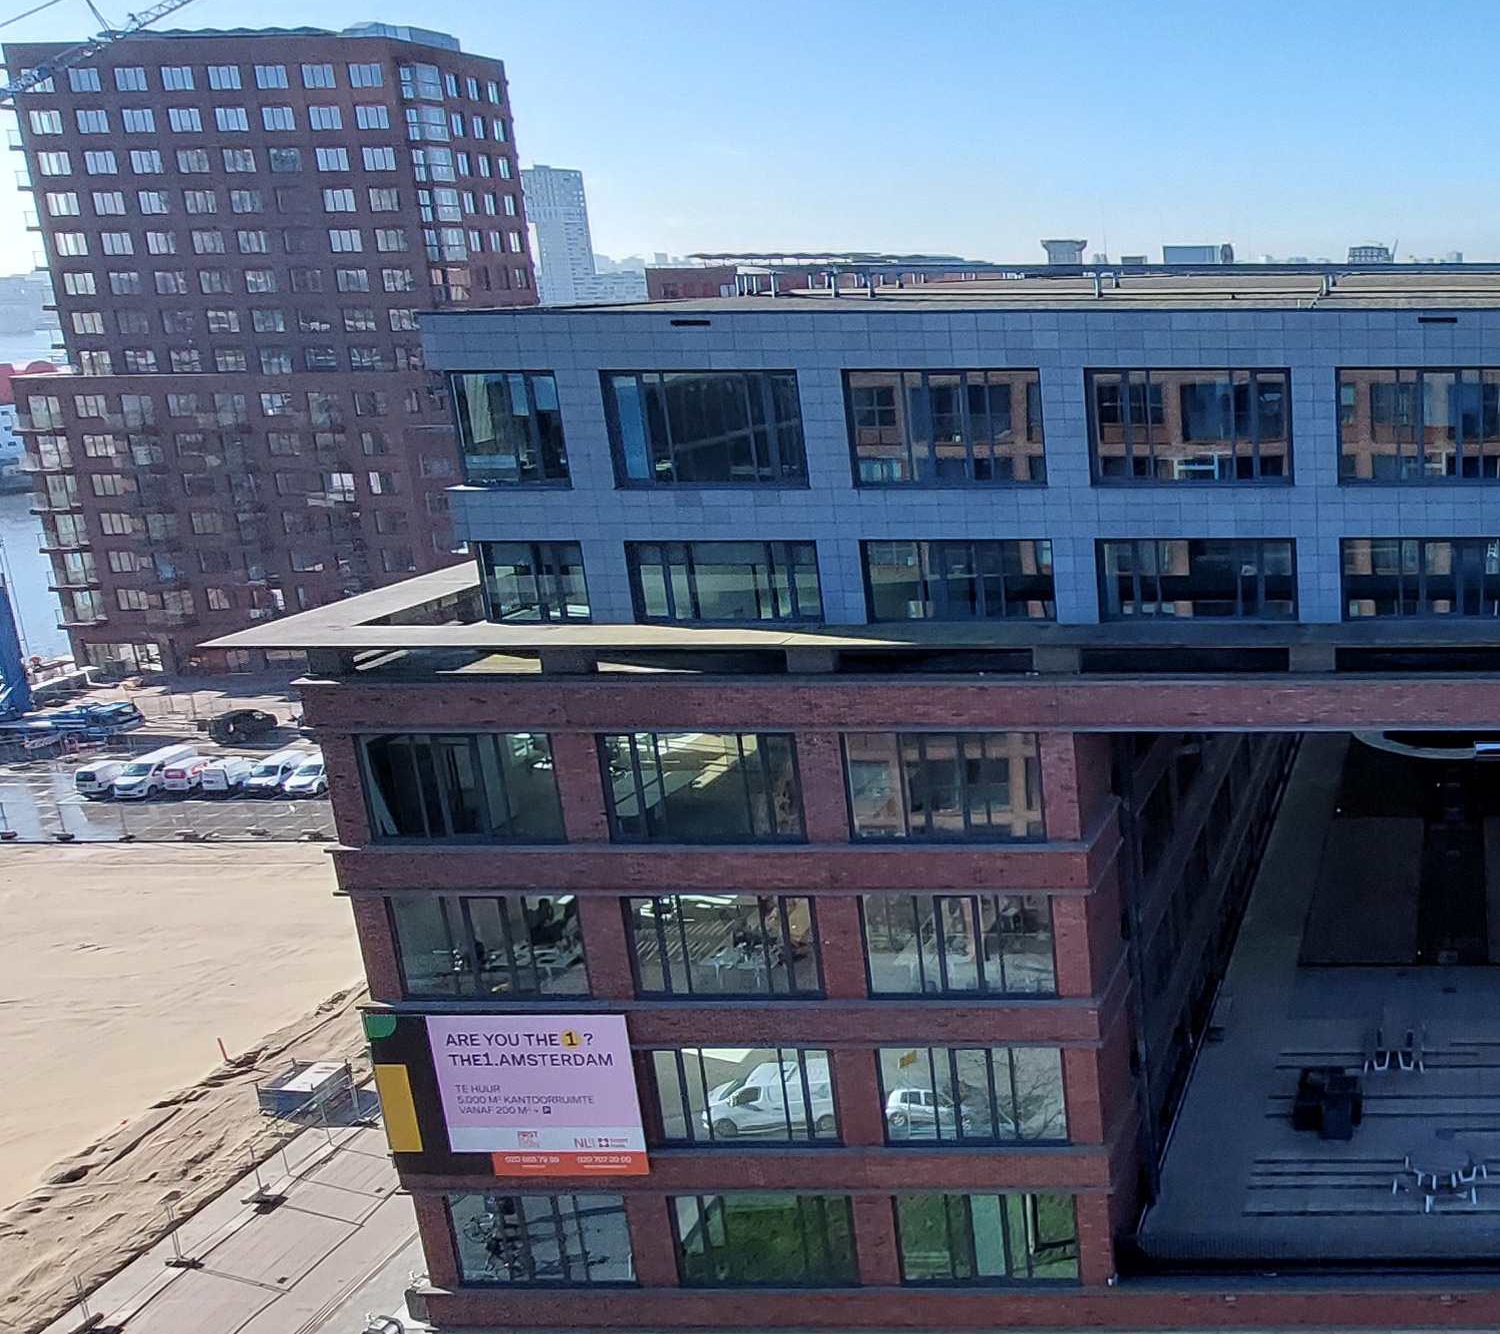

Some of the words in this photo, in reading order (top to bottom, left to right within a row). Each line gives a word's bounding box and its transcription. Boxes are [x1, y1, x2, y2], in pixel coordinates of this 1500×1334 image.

[446, 1033, 480, 1047] ARE
[483, 1033, 520, 1047] YOU
[524, 1033, 560, 1047] THE
[566, 1032, 578, 1047] 1
[583, 1033, 594, 1046] ?
[448, 1053, 614, 1067] THE1.AMSTERDAM
[454, 1084, 469, 1093] TE
[470, 1084, 501, 1093] HUUR
[503, 1095, 595, 1105] KANTOORRUIMTE
[459, 1106, 493, 1115] VANAF
[495, 1106, 516, 1115] 200
